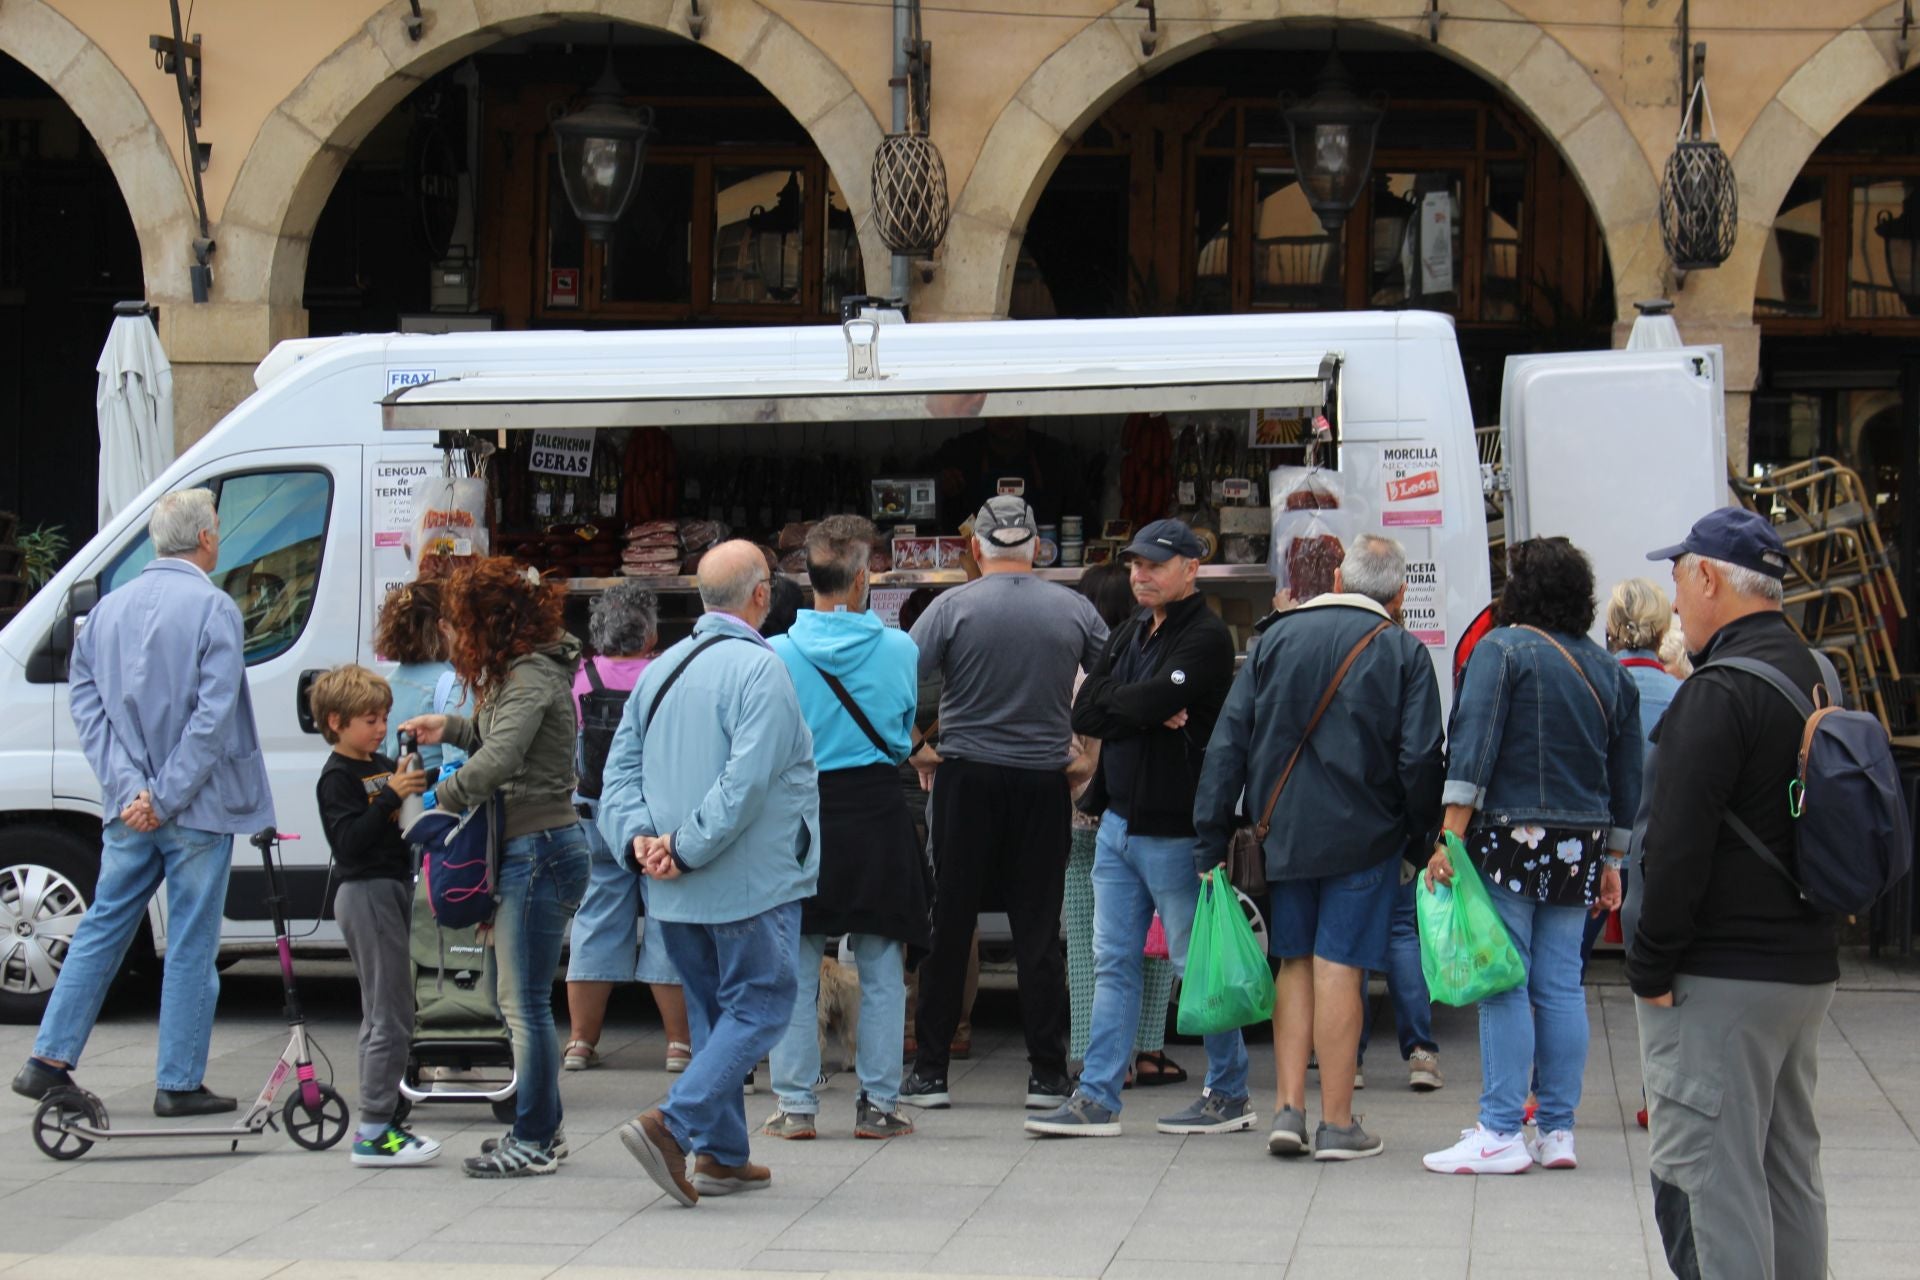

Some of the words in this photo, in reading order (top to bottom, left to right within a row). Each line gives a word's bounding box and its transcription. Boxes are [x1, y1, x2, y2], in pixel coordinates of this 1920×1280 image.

[391, 373, 431, 385] FRAX
[534, 433, 592, 453] SALCHICHON
[1384, 447, 1438, 460] MORCILLA
[532, 451, 588, 472] GERAS
[377, 466, 427, 477] LENGUA
[1396, 470, 1406, 478] DE
[397, 477, 409, 486] de
[375, 487, 413, 497] TERNE
[1405, 563, 1436, 574] NCETA
[1405, 574, 1437, 584] TURAL
[385, 581, 404, 592] CHO
[1402, 608, 1436, 619] OTILLO
